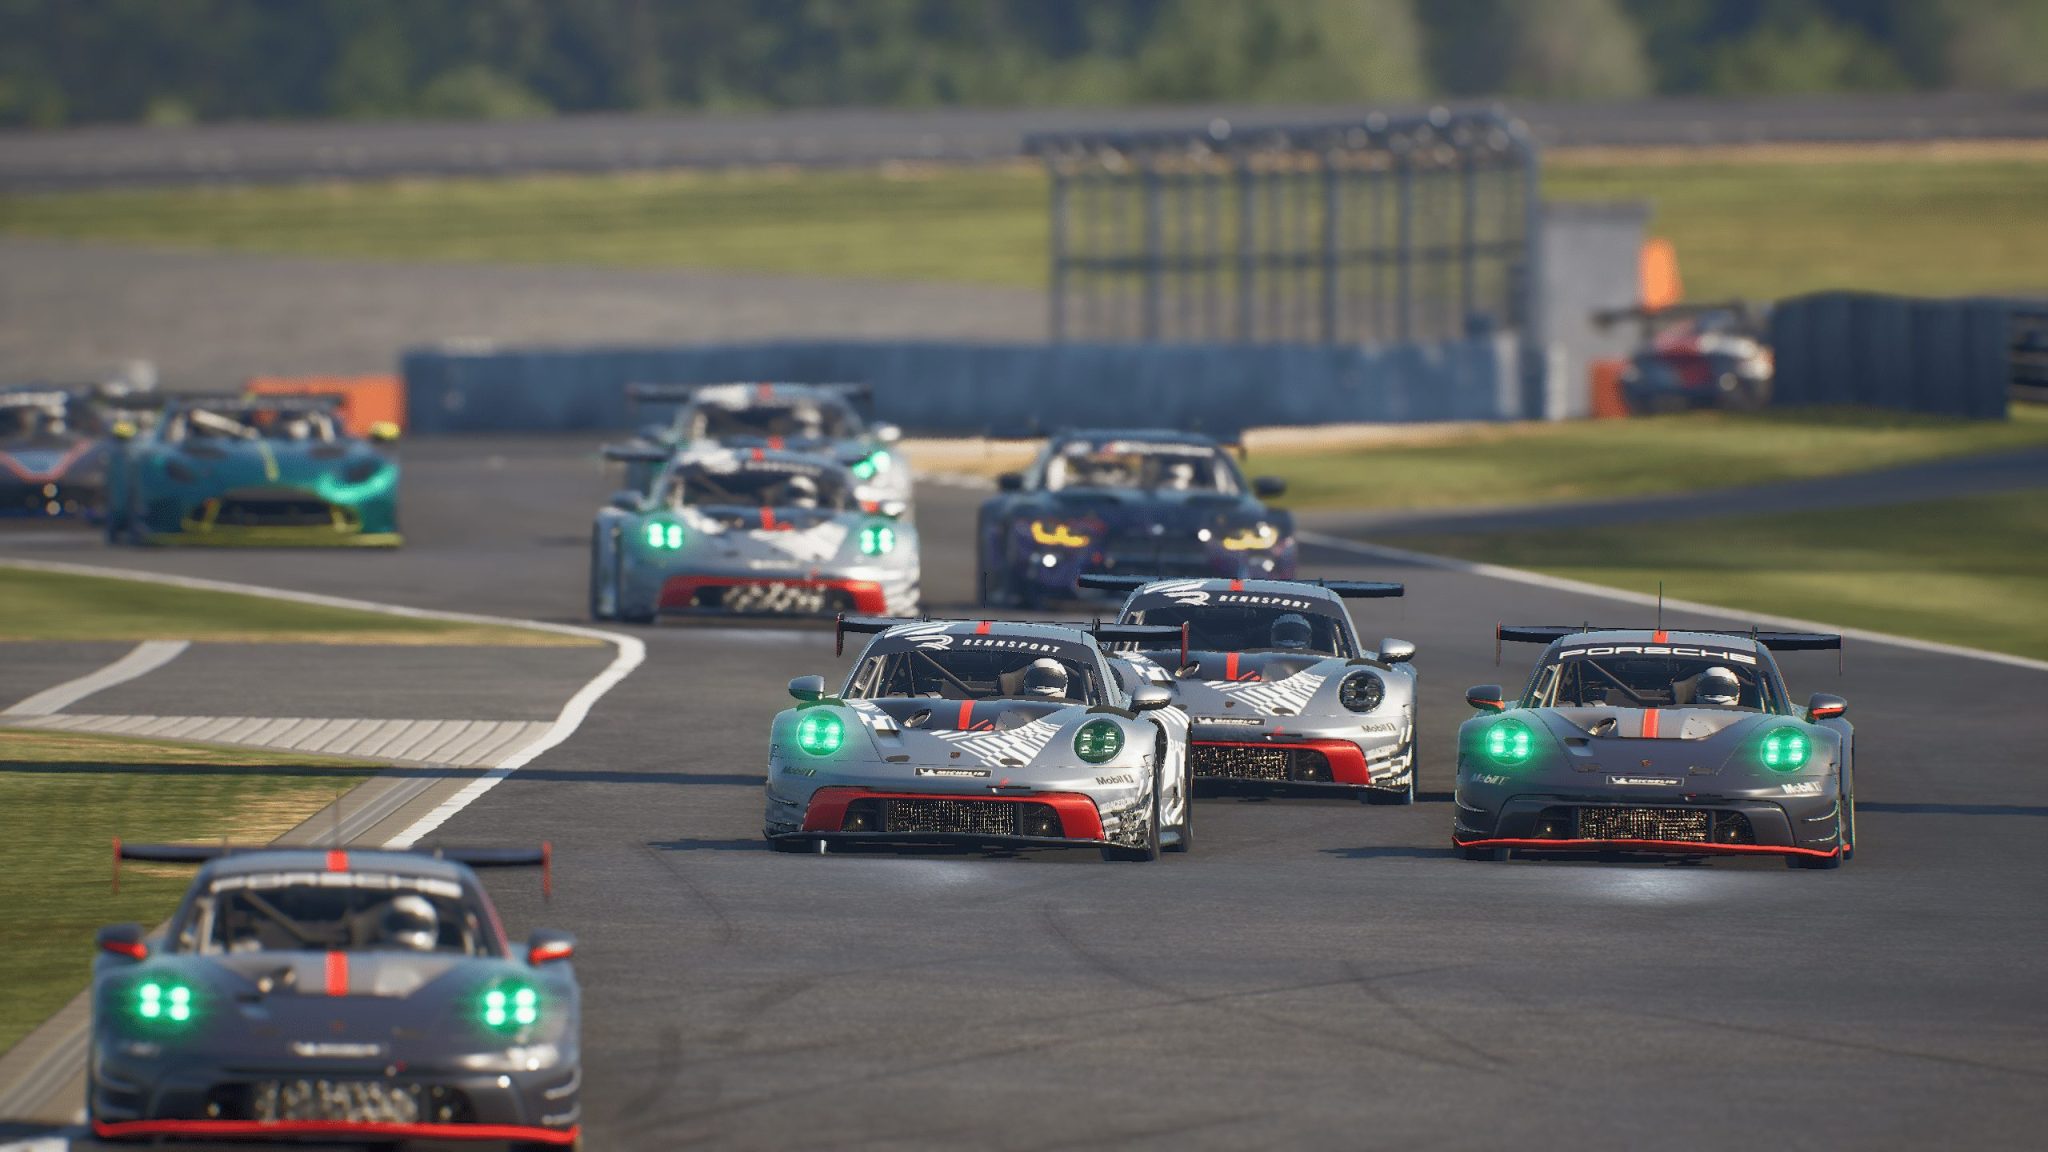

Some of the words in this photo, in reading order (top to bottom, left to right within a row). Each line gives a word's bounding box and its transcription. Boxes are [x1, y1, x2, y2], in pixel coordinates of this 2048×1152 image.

[1219, 594, 1312, 609] RENNSPORT
[962, 638, 1061, 653] RENNSPORT
[1559, 646, 1757, 665] PORSCHE
